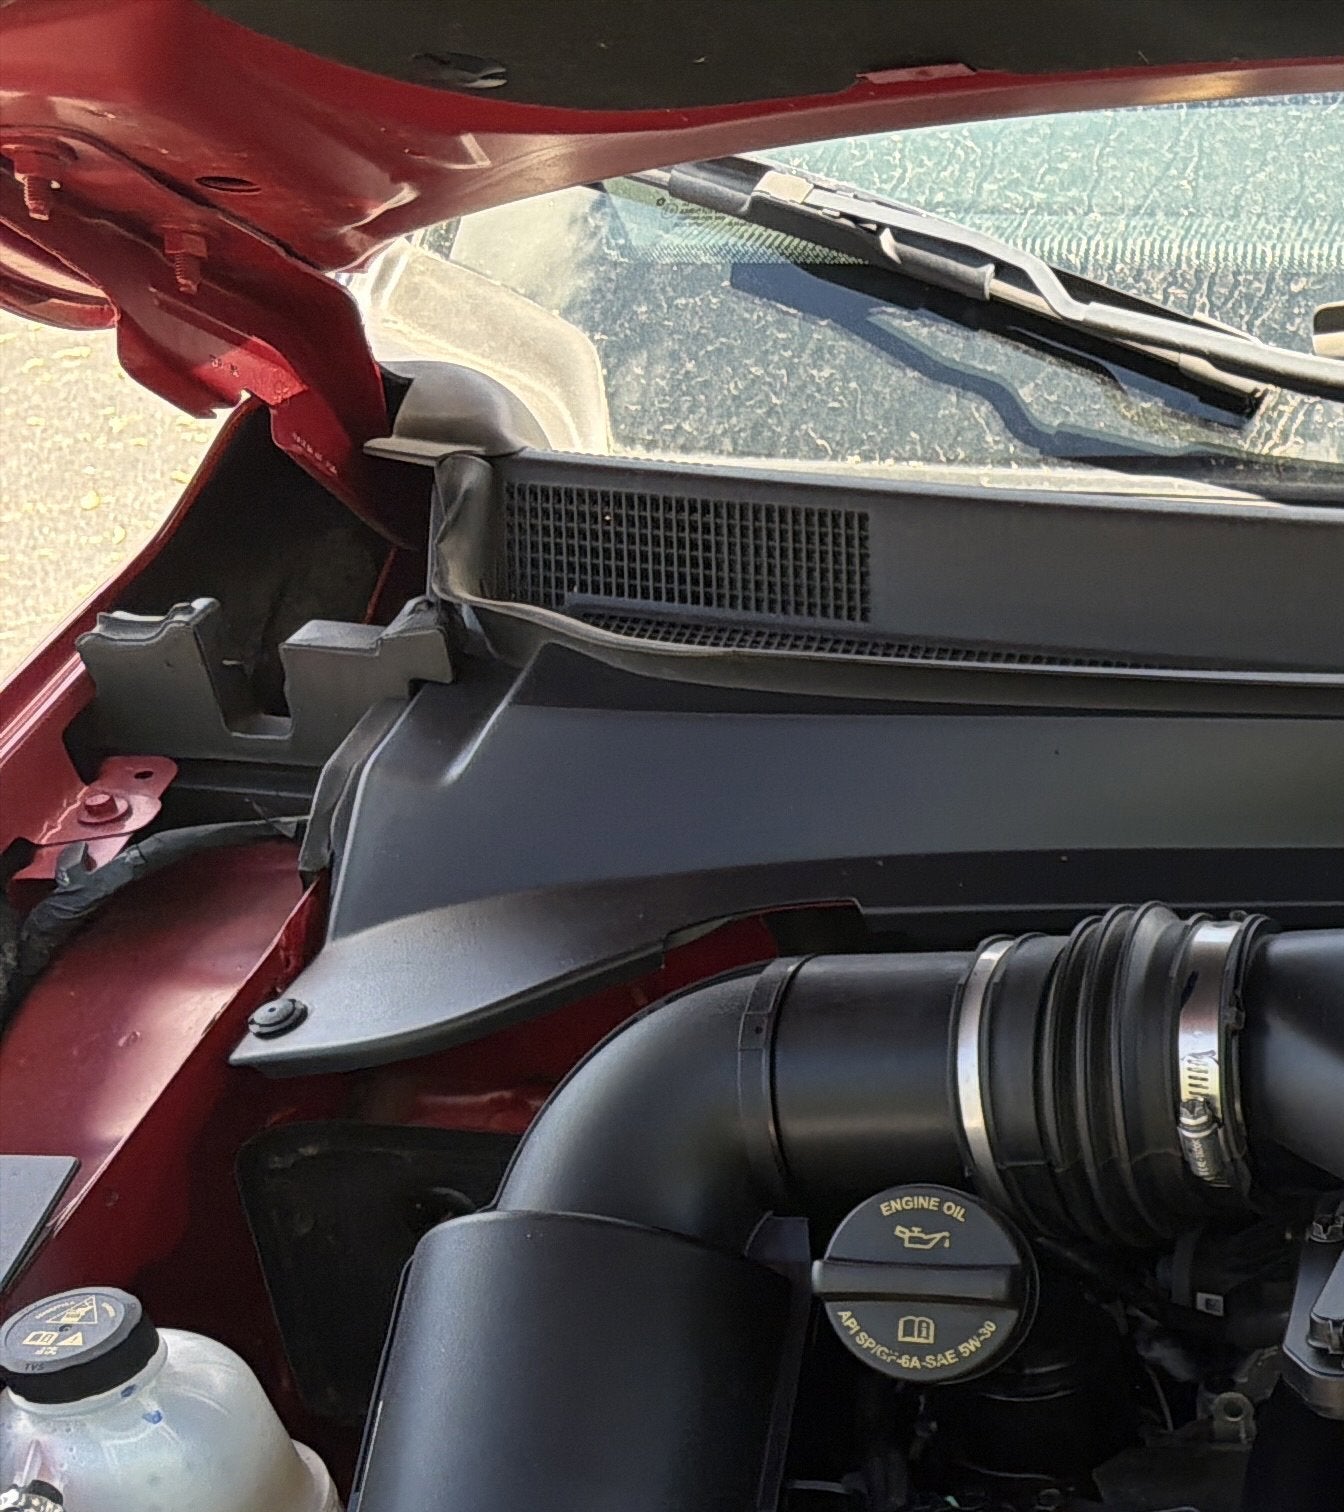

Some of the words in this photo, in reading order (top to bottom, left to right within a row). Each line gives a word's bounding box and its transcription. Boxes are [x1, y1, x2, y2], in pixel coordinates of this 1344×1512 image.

[879, 1195, 940, 1217] ENGINE
[942, 1201, 968, 1222] OIL
[837, 1310, 860, 1336] API
[957, 1320, 997, 1357] 5W-30
